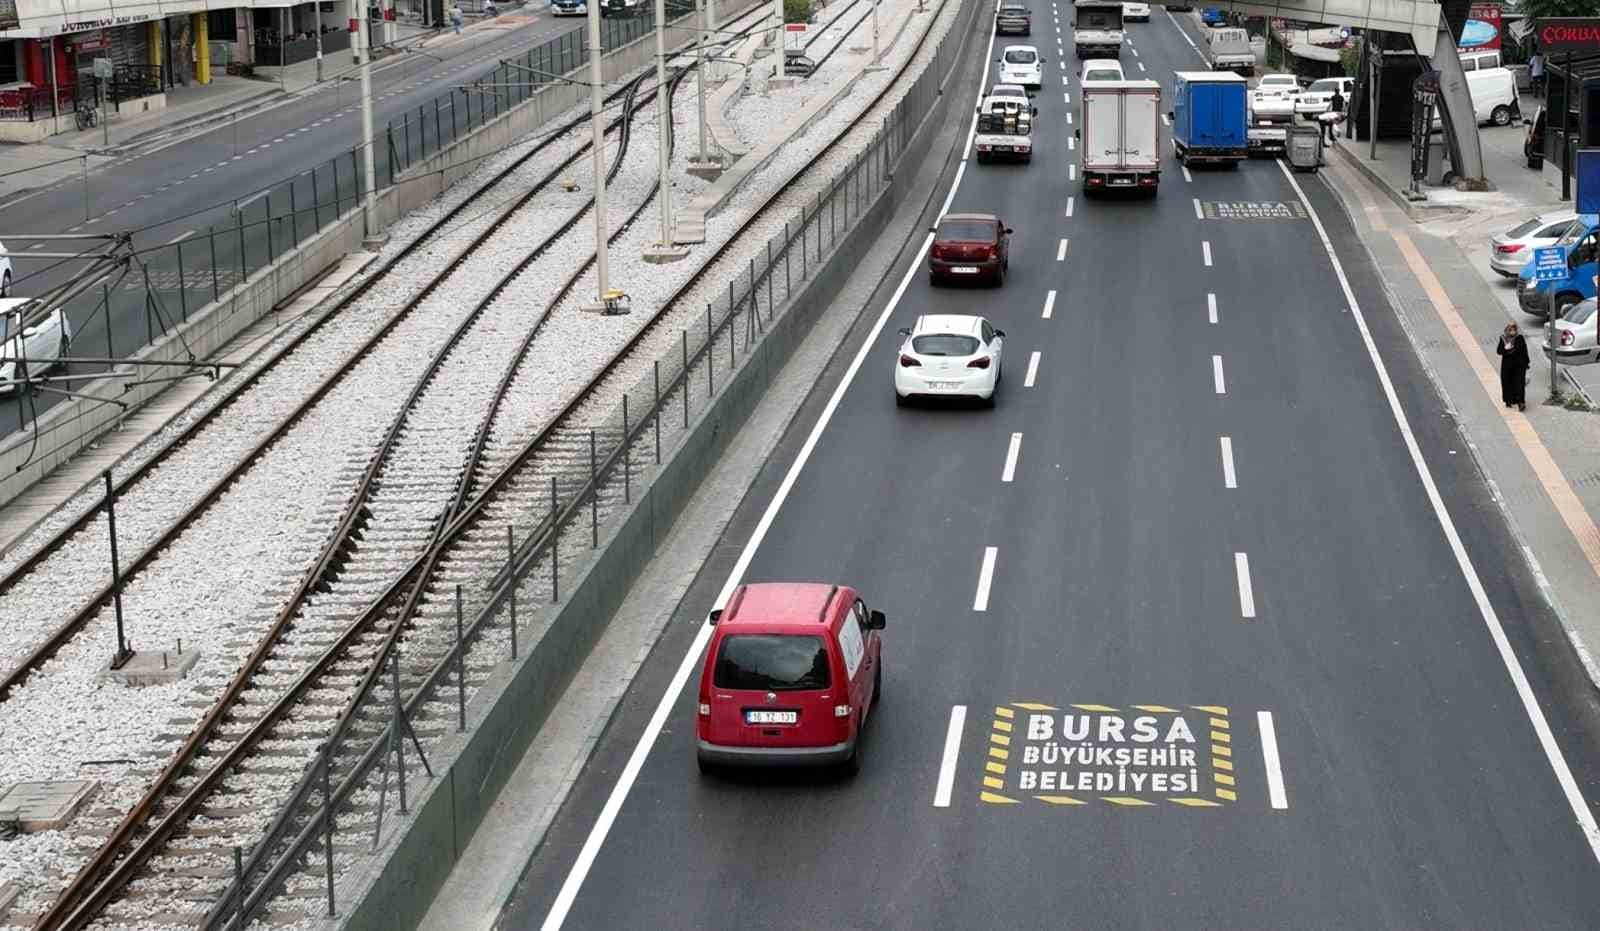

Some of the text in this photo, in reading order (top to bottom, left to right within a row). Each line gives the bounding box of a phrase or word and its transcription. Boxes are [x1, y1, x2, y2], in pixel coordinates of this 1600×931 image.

[1027, 714, 1196, 743] BURSA
[1023, 742, 1198, 767] BÜYÜKŞEHİR
[1019, 765, 1199, 792] BELEDİYESİ
